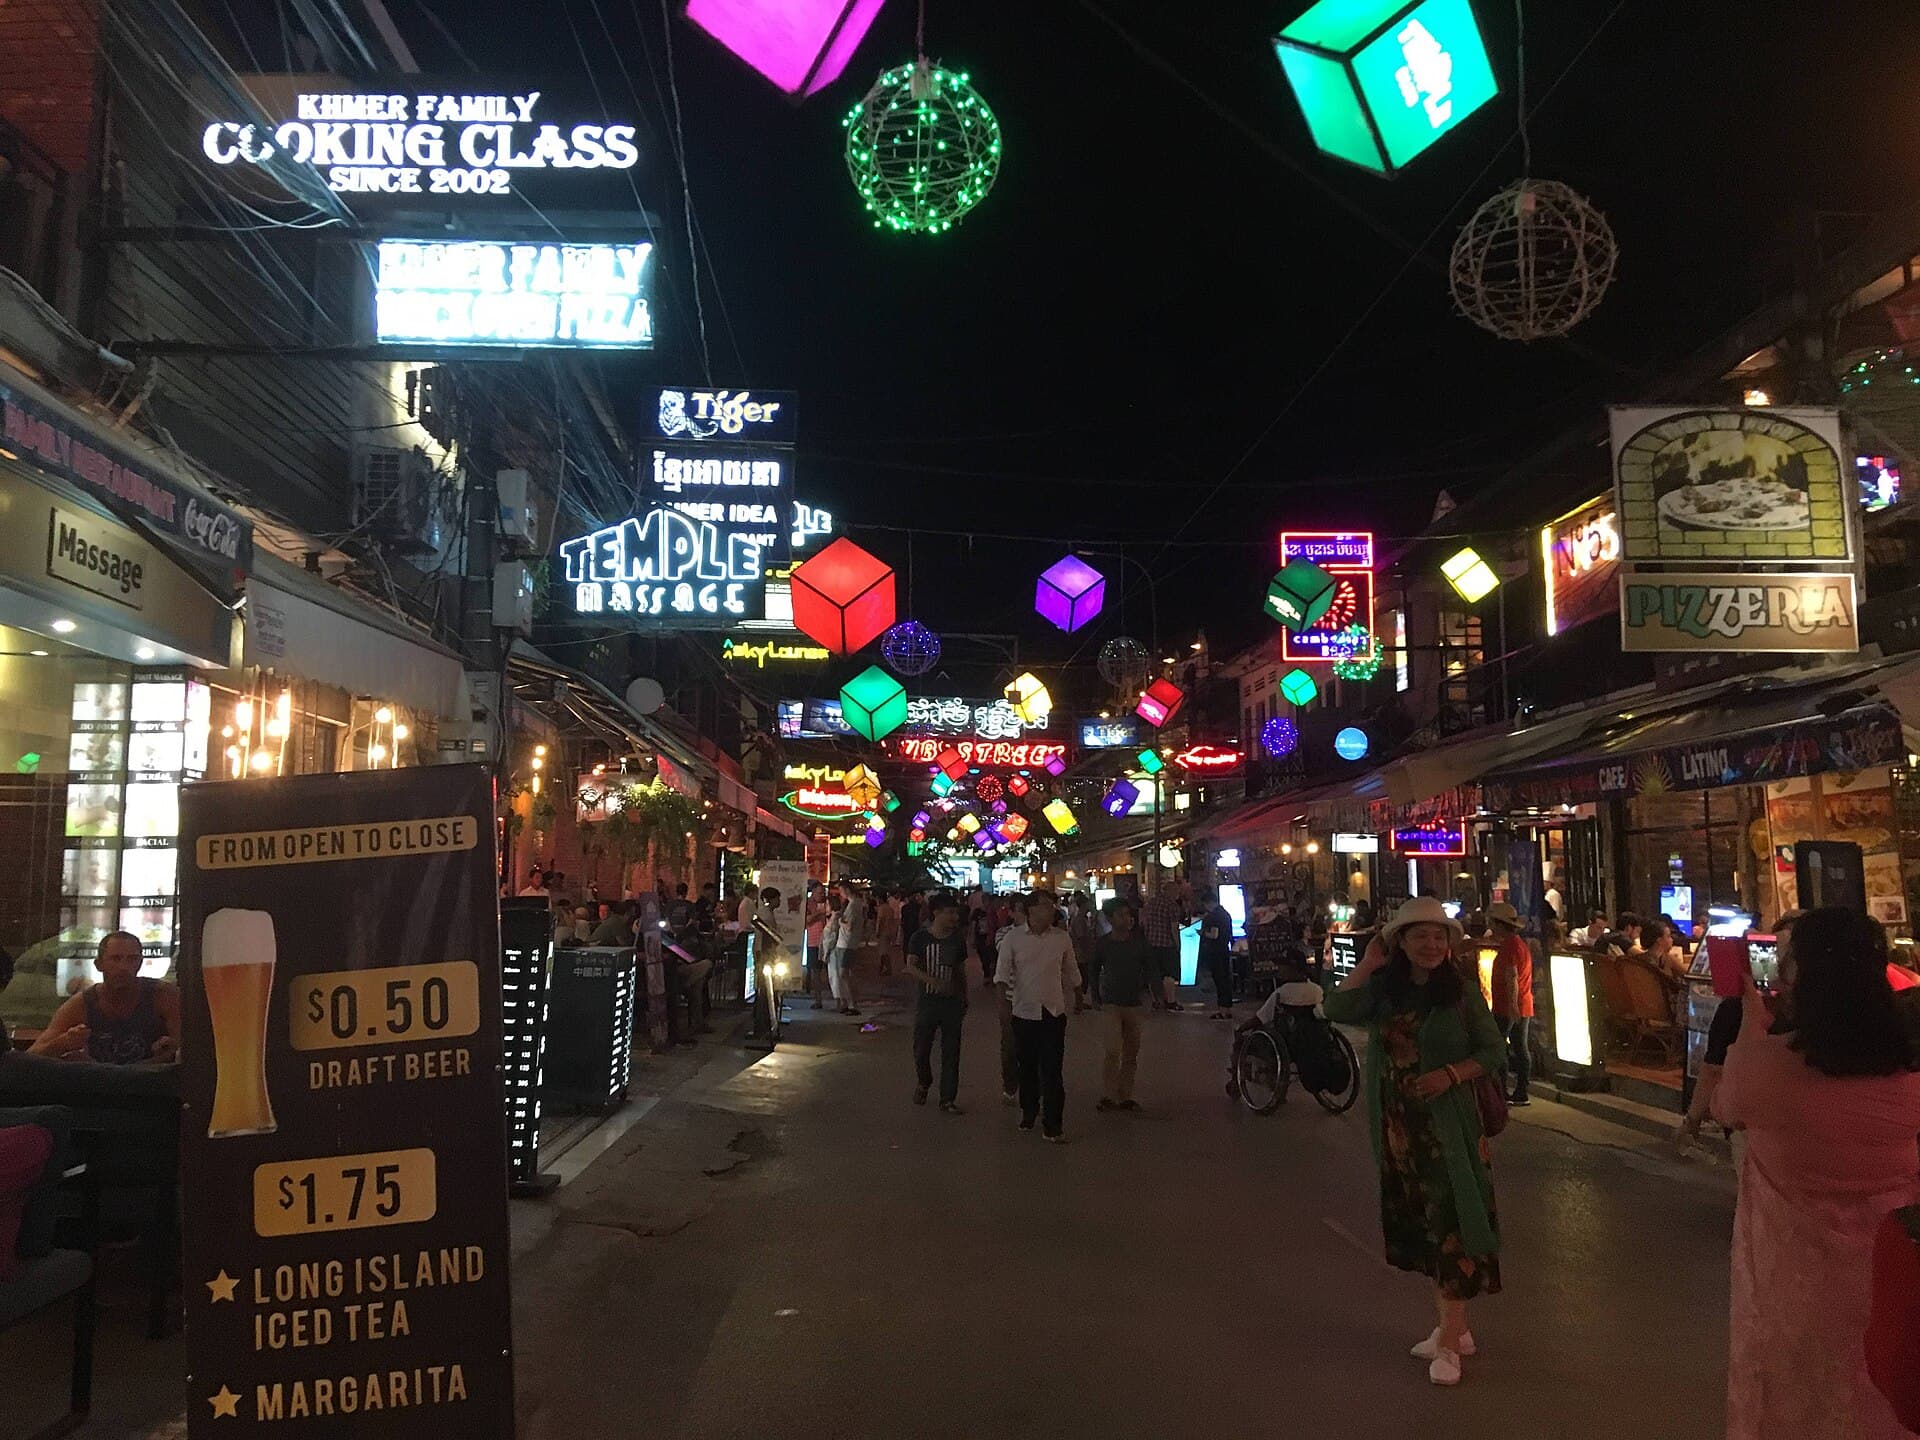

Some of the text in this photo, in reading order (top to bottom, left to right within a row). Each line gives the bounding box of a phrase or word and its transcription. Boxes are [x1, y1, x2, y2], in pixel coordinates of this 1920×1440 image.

[298, 91, 541, 123] KHMER FAMILY
[203, 121, 639, 168] COOKING CLASS
[329, 167, 510, 195] SINCE 2002
[691, 391, 780, 434] Tiger
[728, 504, 778, 523] IDEA
[58, 522, 144, 594] Massage
[560, 508, 761, 582] TEMPLE
[575, 582, 745, 615] MASSAGE
[1626, 585, 1851, 638] PIZZERIA
[1599, 765, 1627, 790] CAFE
[1681, 749, 1729, 781] LATINO
[208, 821, 465, 864] FROM OPEN TO CLOSE
[307, 976, 449, 1040] $0.50
[309, 1048, 472, 1090] DRAFT BEER
[278, 1164, 401, 1225] $1.75
[254, 1245, 485, 1304] LONG ISLAND
[255, 1300, 411, 1351] ICED TEA
[256, 1364, 468, 1422] MARGARITA
